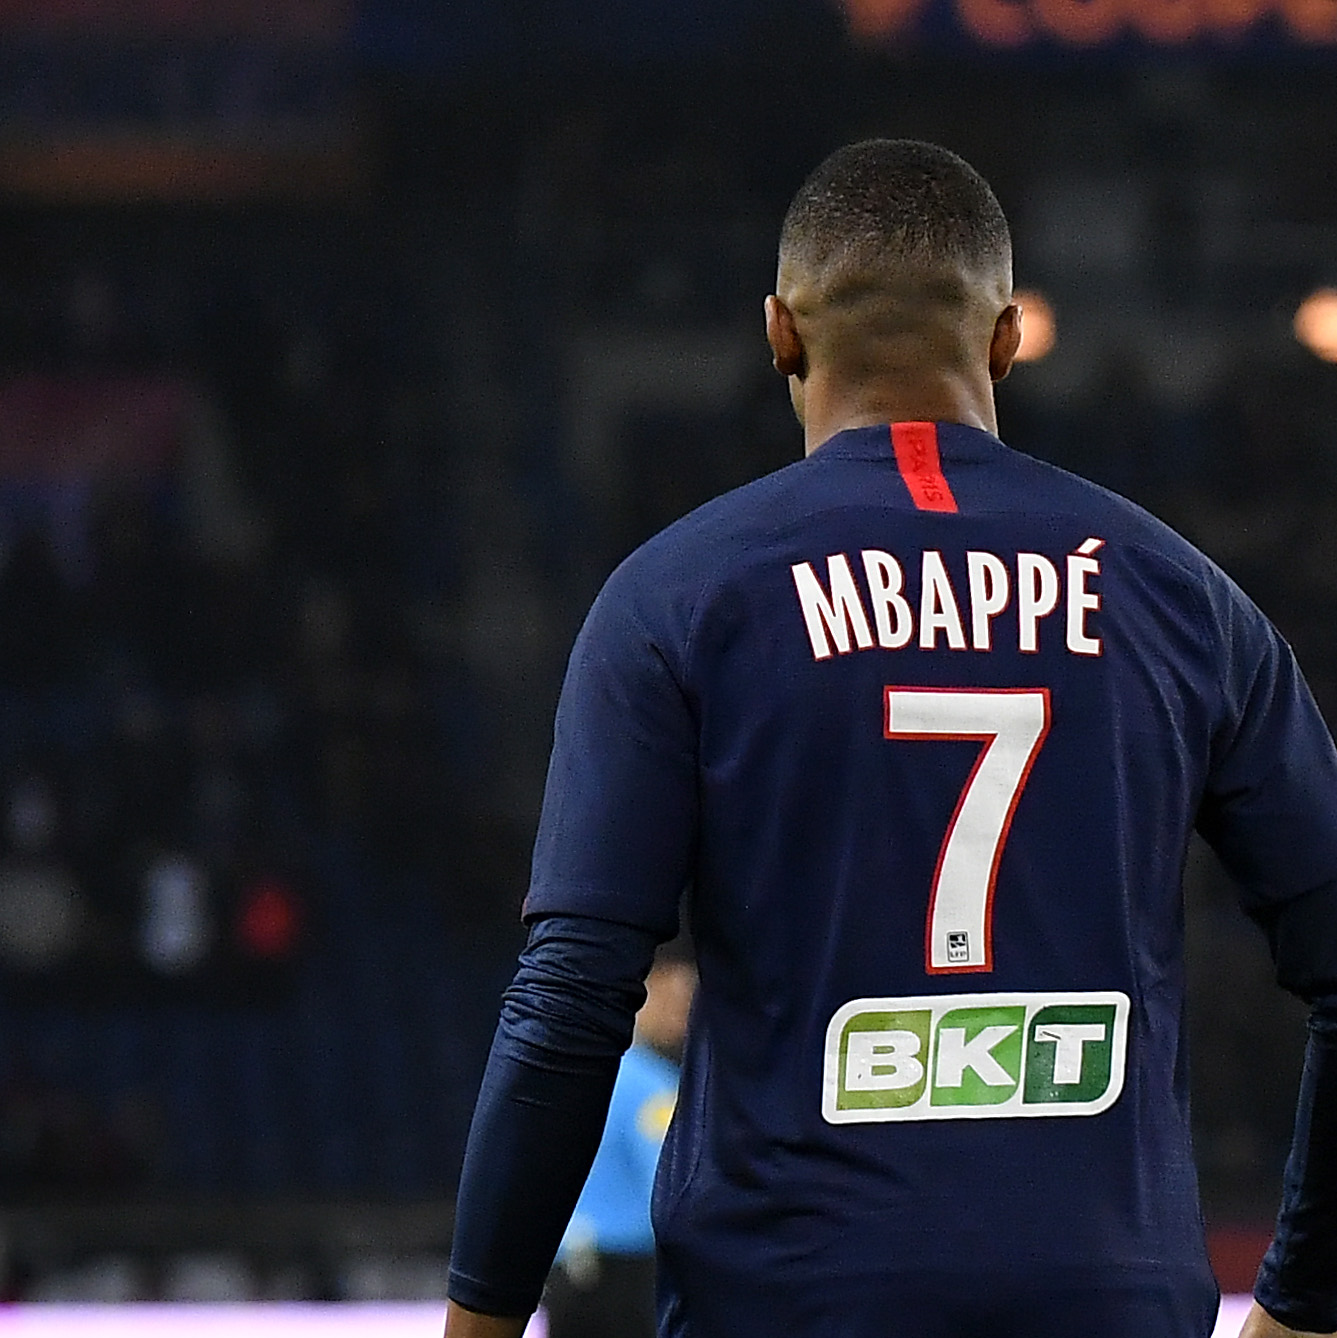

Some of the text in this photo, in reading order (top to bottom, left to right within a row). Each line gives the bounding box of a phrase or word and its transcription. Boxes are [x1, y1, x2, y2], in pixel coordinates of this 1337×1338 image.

[791, 536, 1106, 661] MBAPPÉ
[884, 685, 1051, 975] 7
[844, 1023, 1106, 1092] BKT
